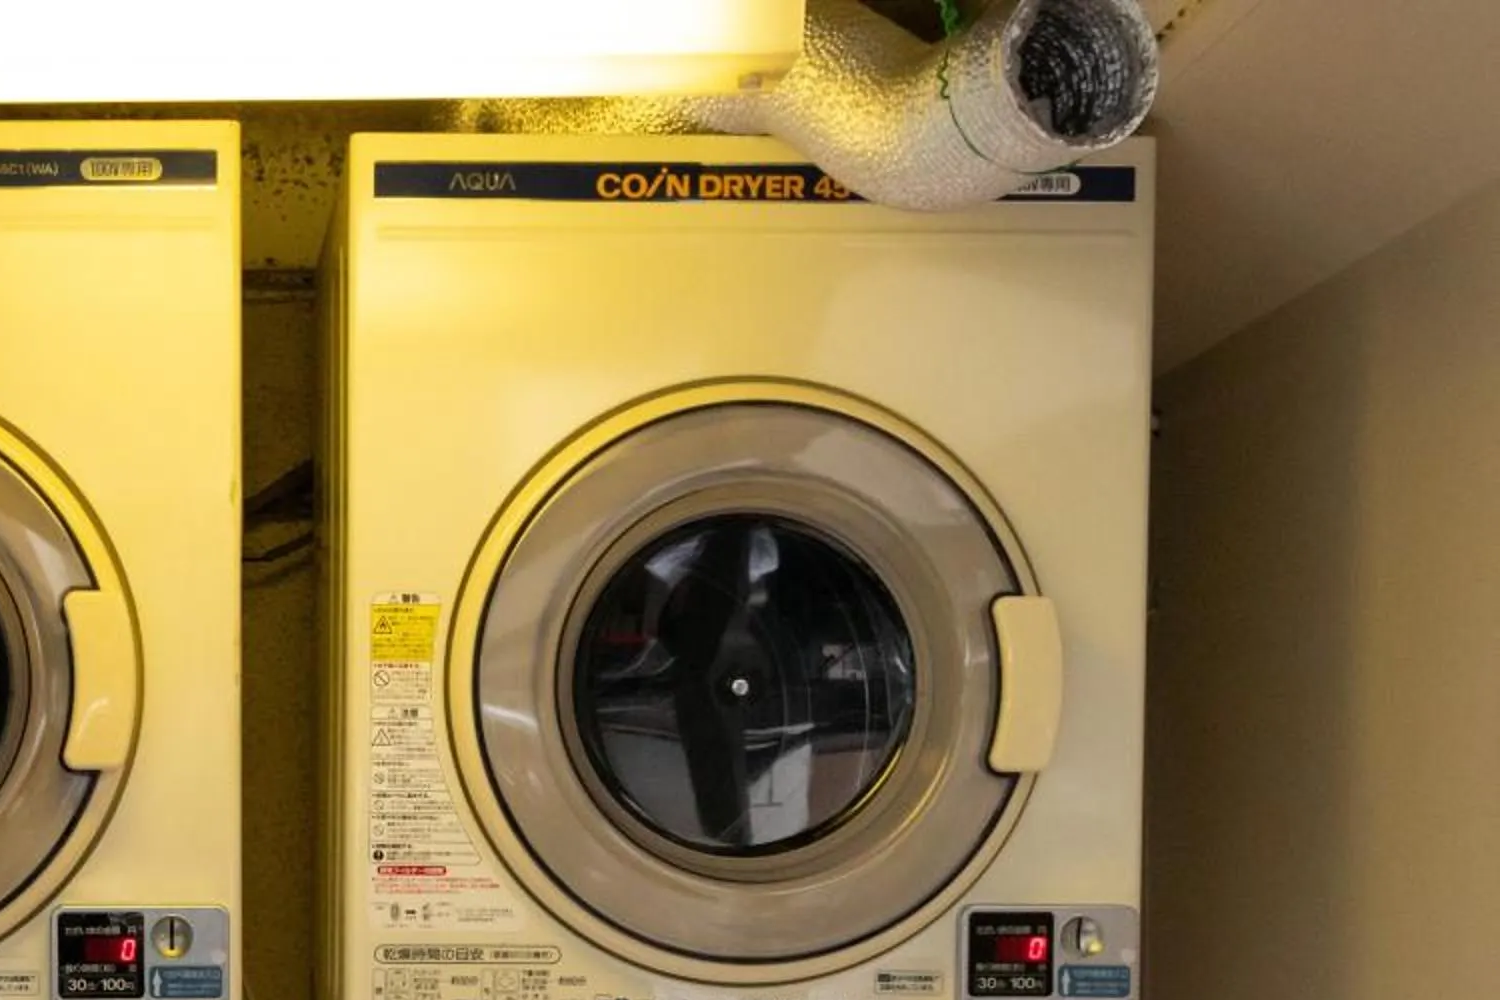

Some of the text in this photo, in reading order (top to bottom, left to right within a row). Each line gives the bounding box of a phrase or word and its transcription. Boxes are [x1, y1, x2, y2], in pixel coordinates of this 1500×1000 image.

[449, 172, 516, 191] AQUA
[701, 174, 803, 199] DRYER
[121, 939, 136, 961] 0
[1028, 937, 1045, 961] 0
